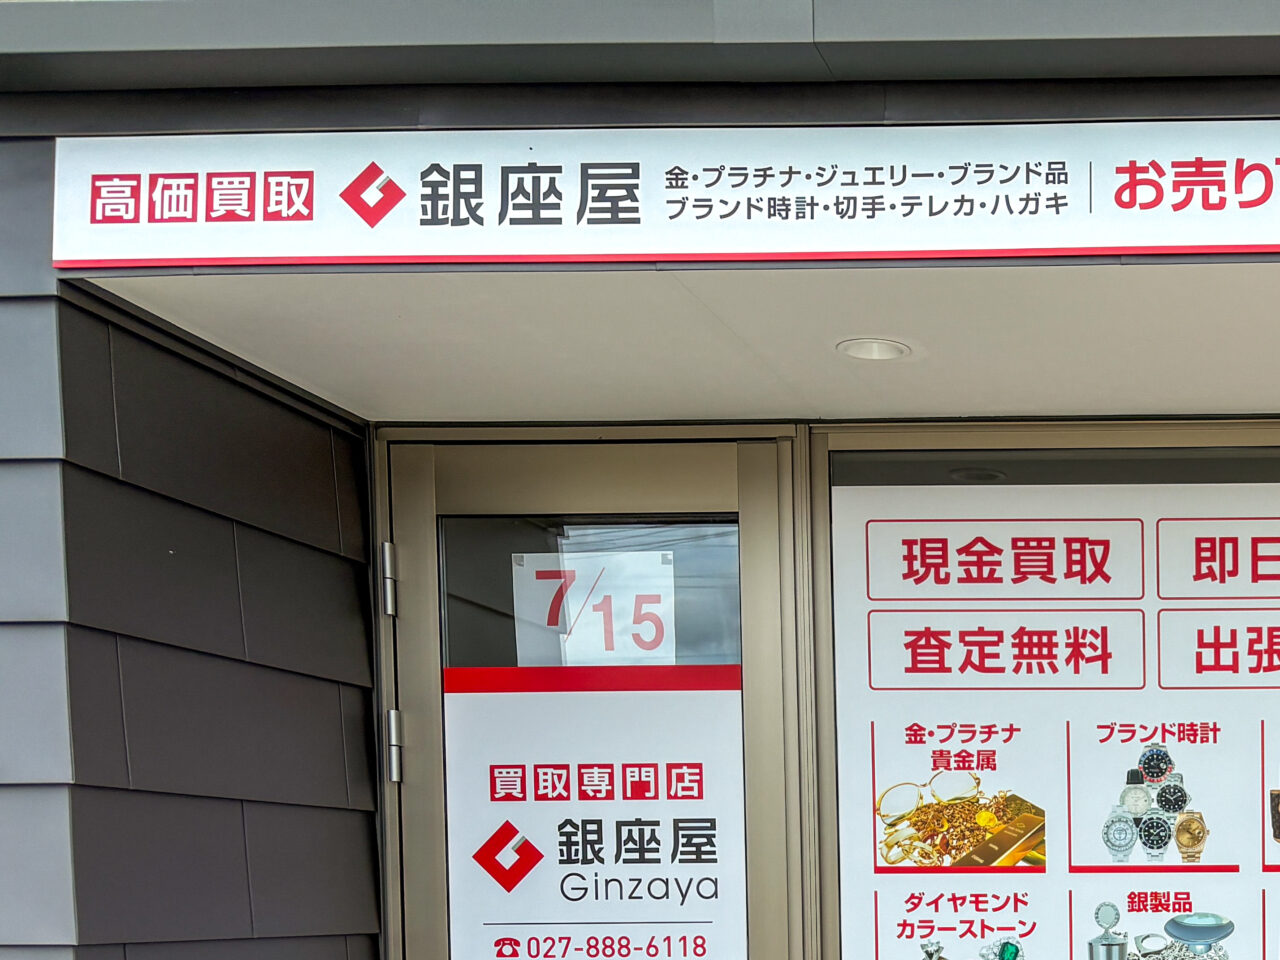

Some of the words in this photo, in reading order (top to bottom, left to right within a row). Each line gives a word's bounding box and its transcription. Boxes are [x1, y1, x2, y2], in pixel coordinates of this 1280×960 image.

[665, 161, 1068, 189] 金・プラチナ・ジュエリー・ブランド品
[92, 172, 313, 223] 高価買取
[420, 162, 641, 227] 銀座屋
[666, 192, 1069, 220] ブランド時計・切手・テレカ・ハガキ
[901, 536, 1112, 585] 現金買取
[903, 626, 1113, 675] 査定無料
[905, 723, 1021, 745] 金・プラチナ
[1097, 722, 1221, 744] ブランド時計
[931, 749, 997, 771] 貴金属
[490, 763, 703, 801] 買取専門店
[557, 818, 718, 865] 銀座屋
[560, 872, 718, 905] Ginzaya
[904, 892, 1029, 913] ダイヤモンド
[1127, 891, 1193, 913] 銀製品
[897, 920, 1037, 940] カラーストーン
[527, 935, 707, 959] 027-888-6118
